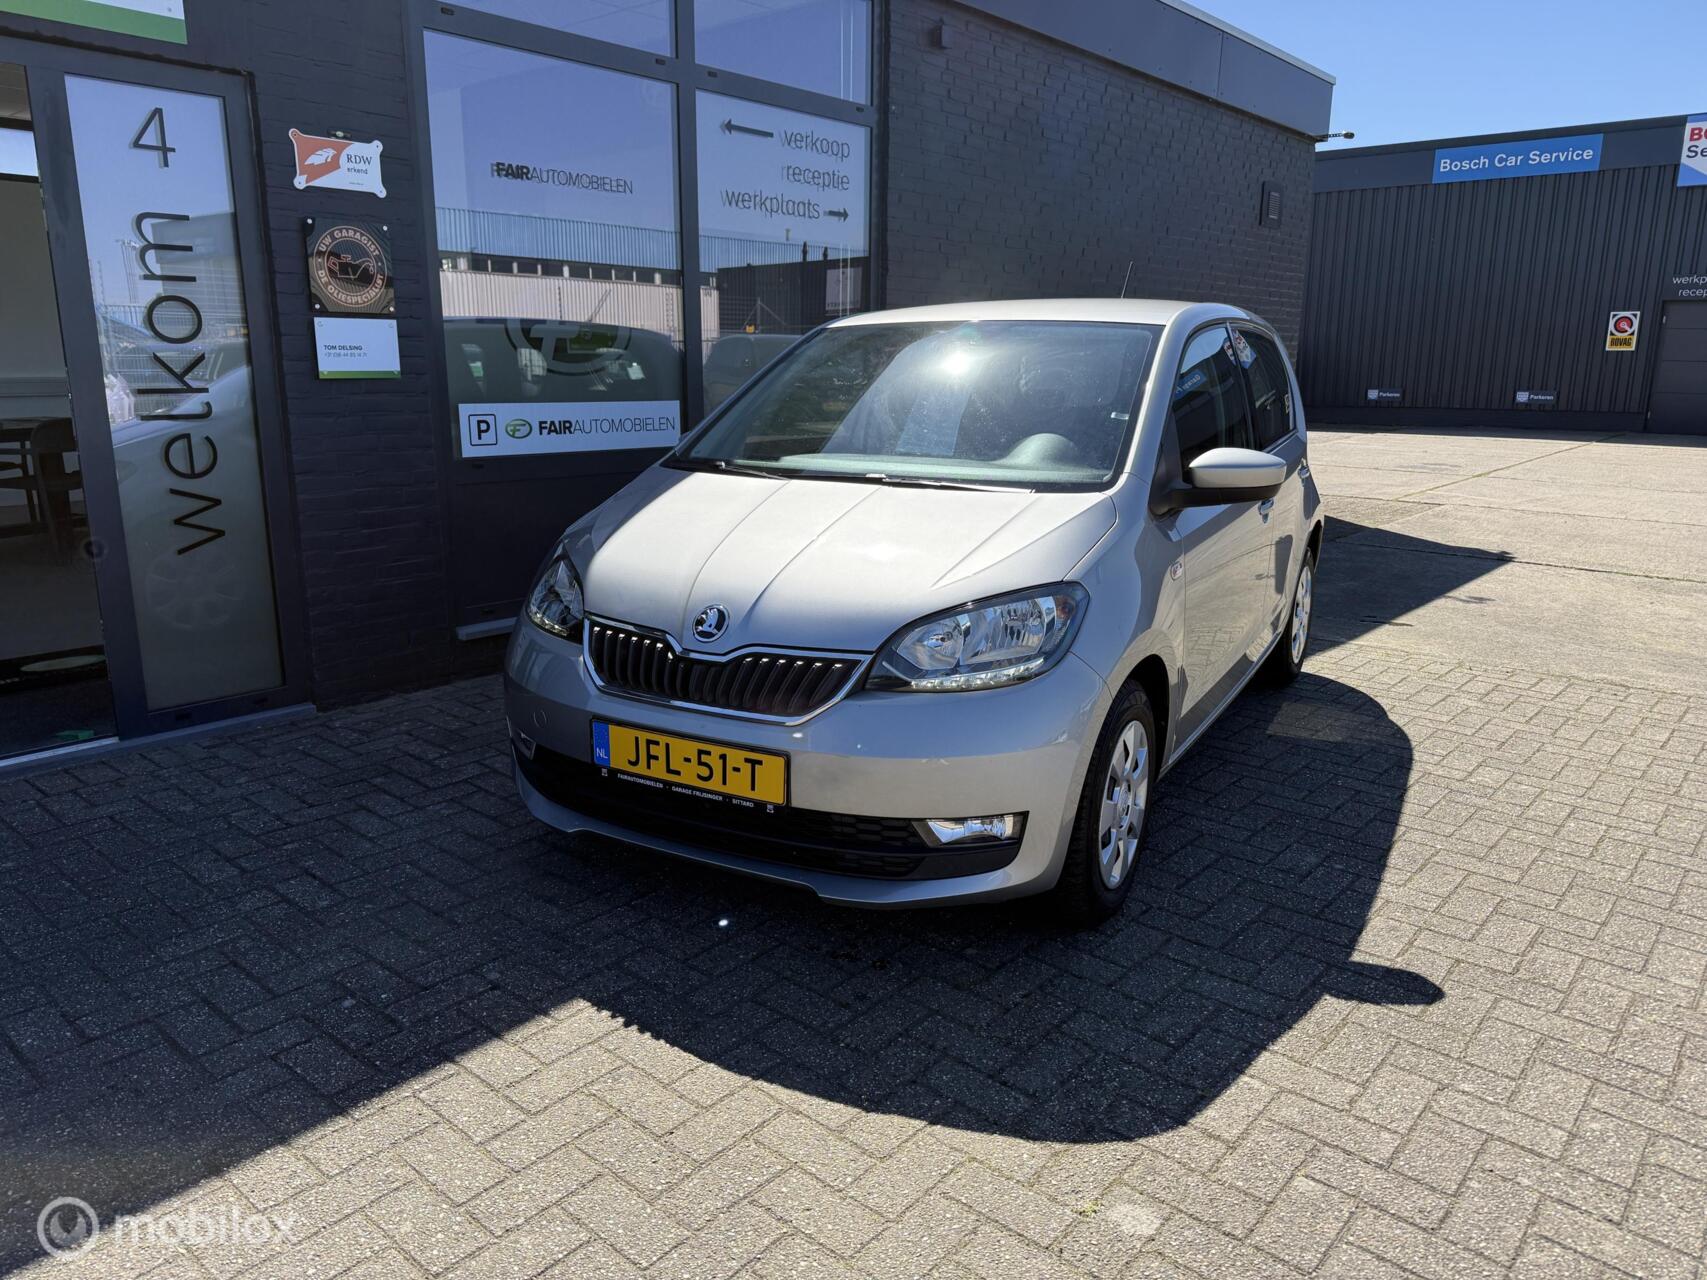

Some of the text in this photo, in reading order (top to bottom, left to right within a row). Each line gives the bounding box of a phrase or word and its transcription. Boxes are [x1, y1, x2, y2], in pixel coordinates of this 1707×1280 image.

[130, 106, 177, 168] 4
[783, 129, 851, 161] verkoop
[346, 153, 373, 166] RDW
[347, 166, 368, 175] erkend
[1439, 147, 1594, 172] Bosch Car Service
[493, 161, 634, 195] FAIRAUTOMOBIELEN
[785, 164, 851, 192] receptie
[724, 188, 821, 219] werkplaats
[319, 229, 380, 256] UW GARAGIST
[1610, 337, 1632, 347] BOVAG
[134, 211, 227, 556] welkom
[476, 419, 490, 440] P
[538, 416, 676, 435] FAIRAUTOMOBIELEN
[596, 735, 764, 792] NL JFL-51-T
